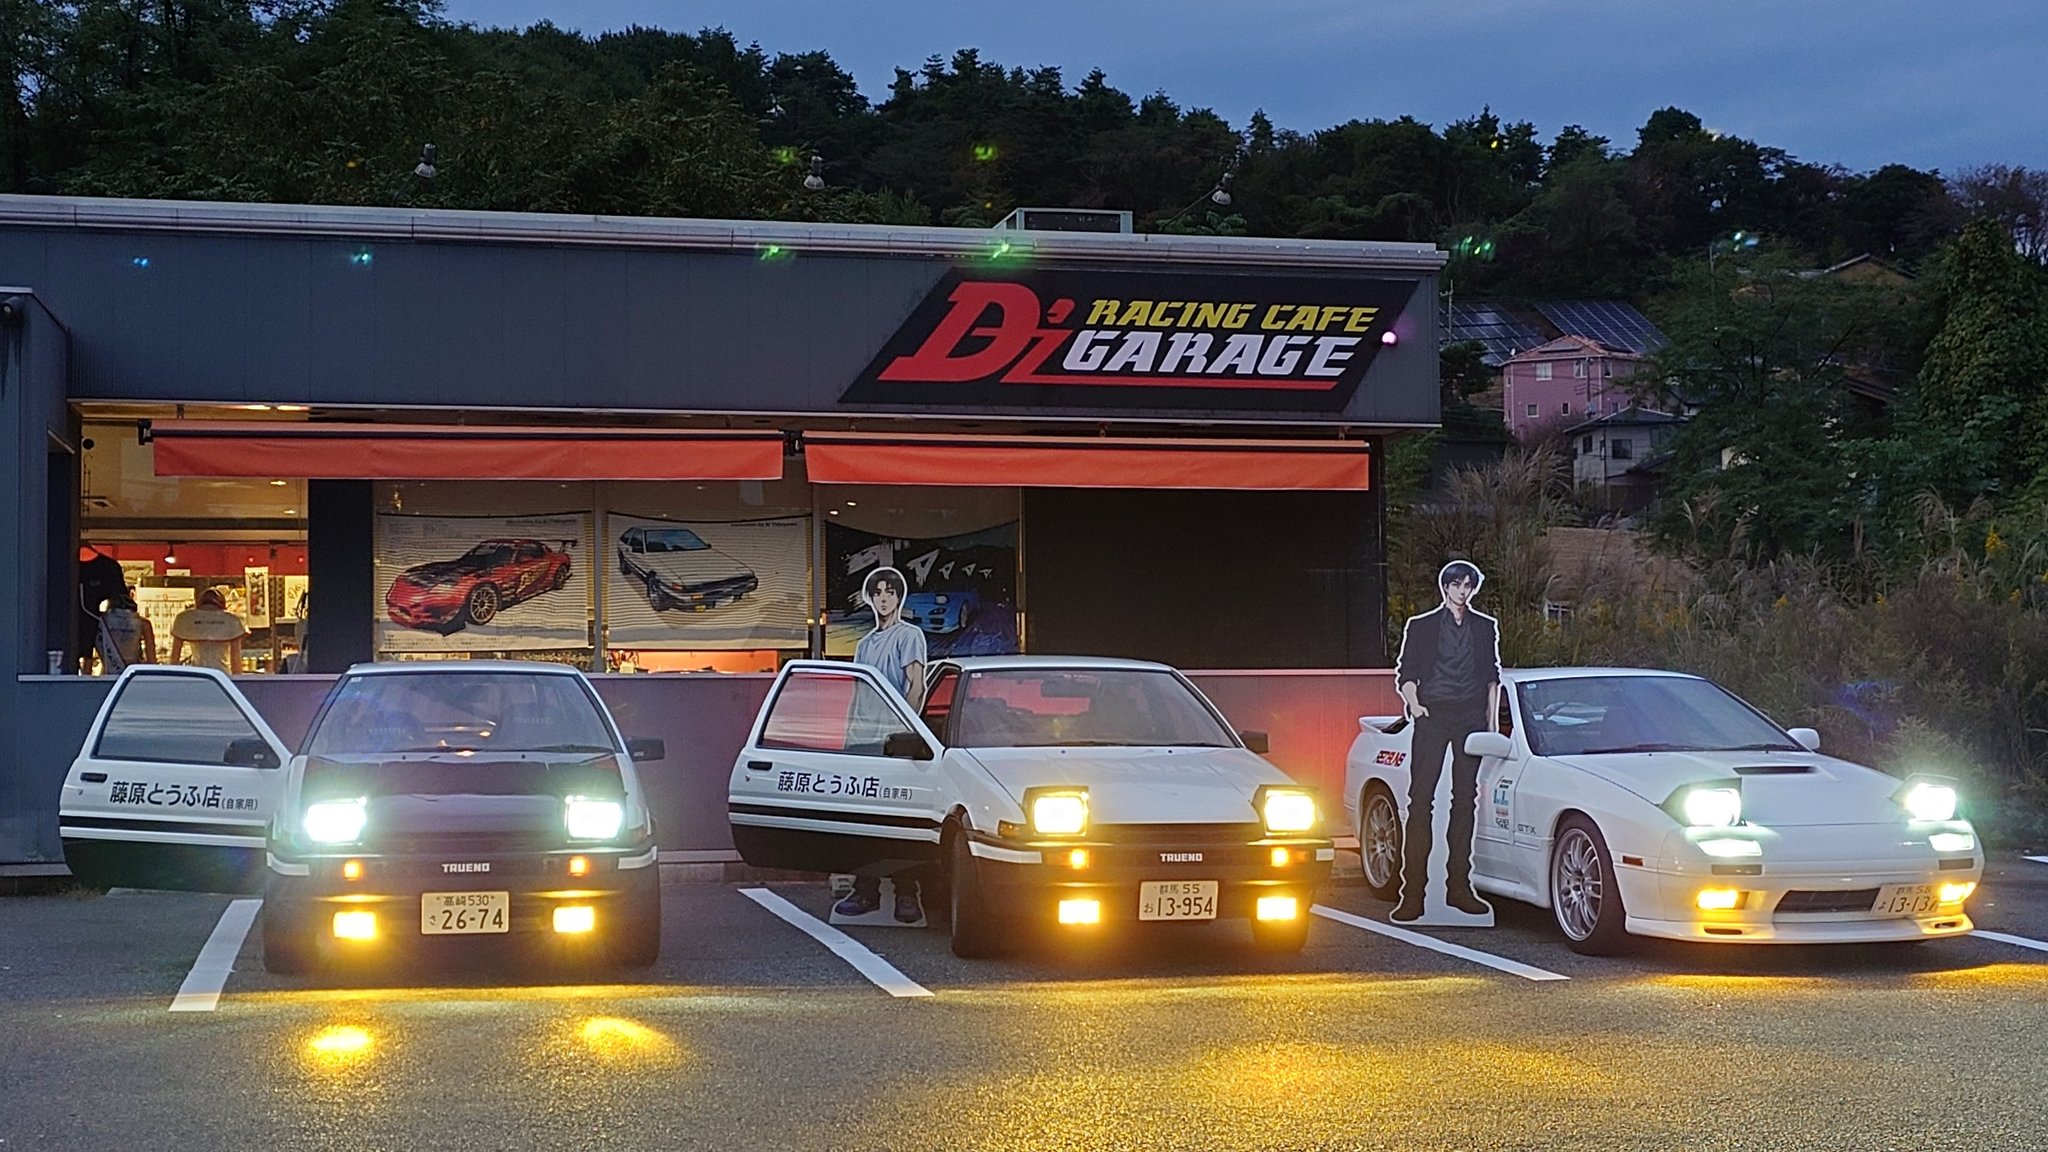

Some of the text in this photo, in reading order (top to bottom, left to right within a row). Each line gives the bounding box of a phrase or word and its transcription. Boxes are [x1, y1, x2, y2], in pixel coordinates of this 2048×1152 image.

[1084, 299, 1381, 333] RACING CAFE
[1062, 329, 1363, 377] GARAGE
[109, 781, 222, 809] 藤原とうふ店
[778, 771, 880, 798] 藤原とうふ店
[441, 862, 491, 873] TRUENO
[1159, 852, 1204, 863] TRUENO
[1157, 896, 1214, 917] 13-954
[441, 908, 504, 931] 26-74
